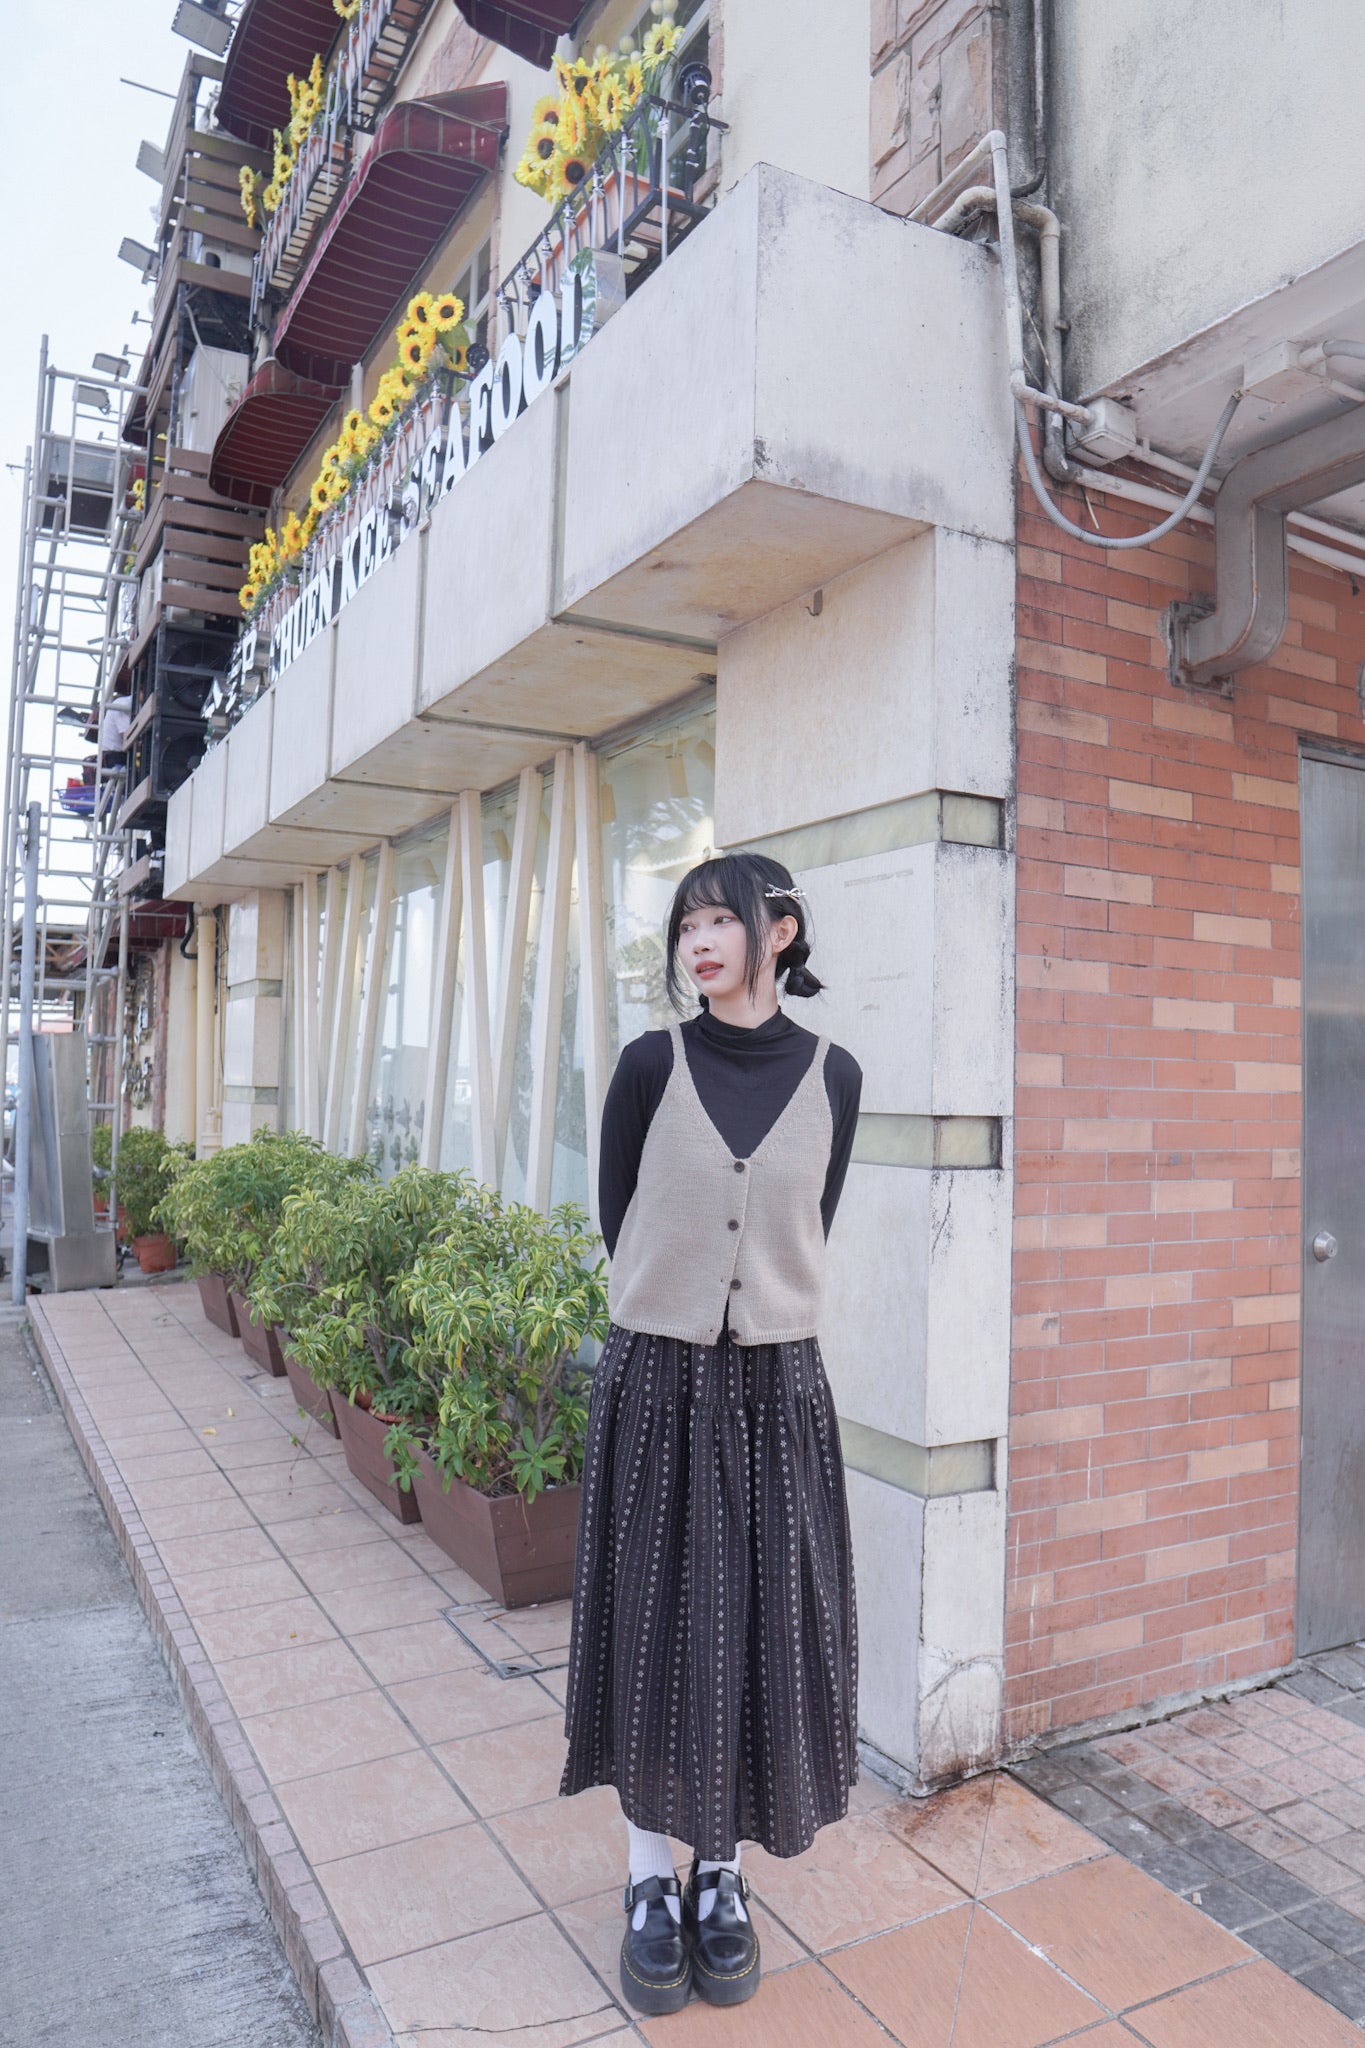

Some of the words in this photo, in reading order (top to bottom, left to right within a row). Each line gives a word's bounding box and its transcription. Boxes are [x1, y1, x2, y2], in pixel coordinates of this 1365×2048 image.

[269, 554, 336, 684] CHUEN
[340, 483, 394, 611] KEE
[400, 247, 596, 545] SEAFOOD
